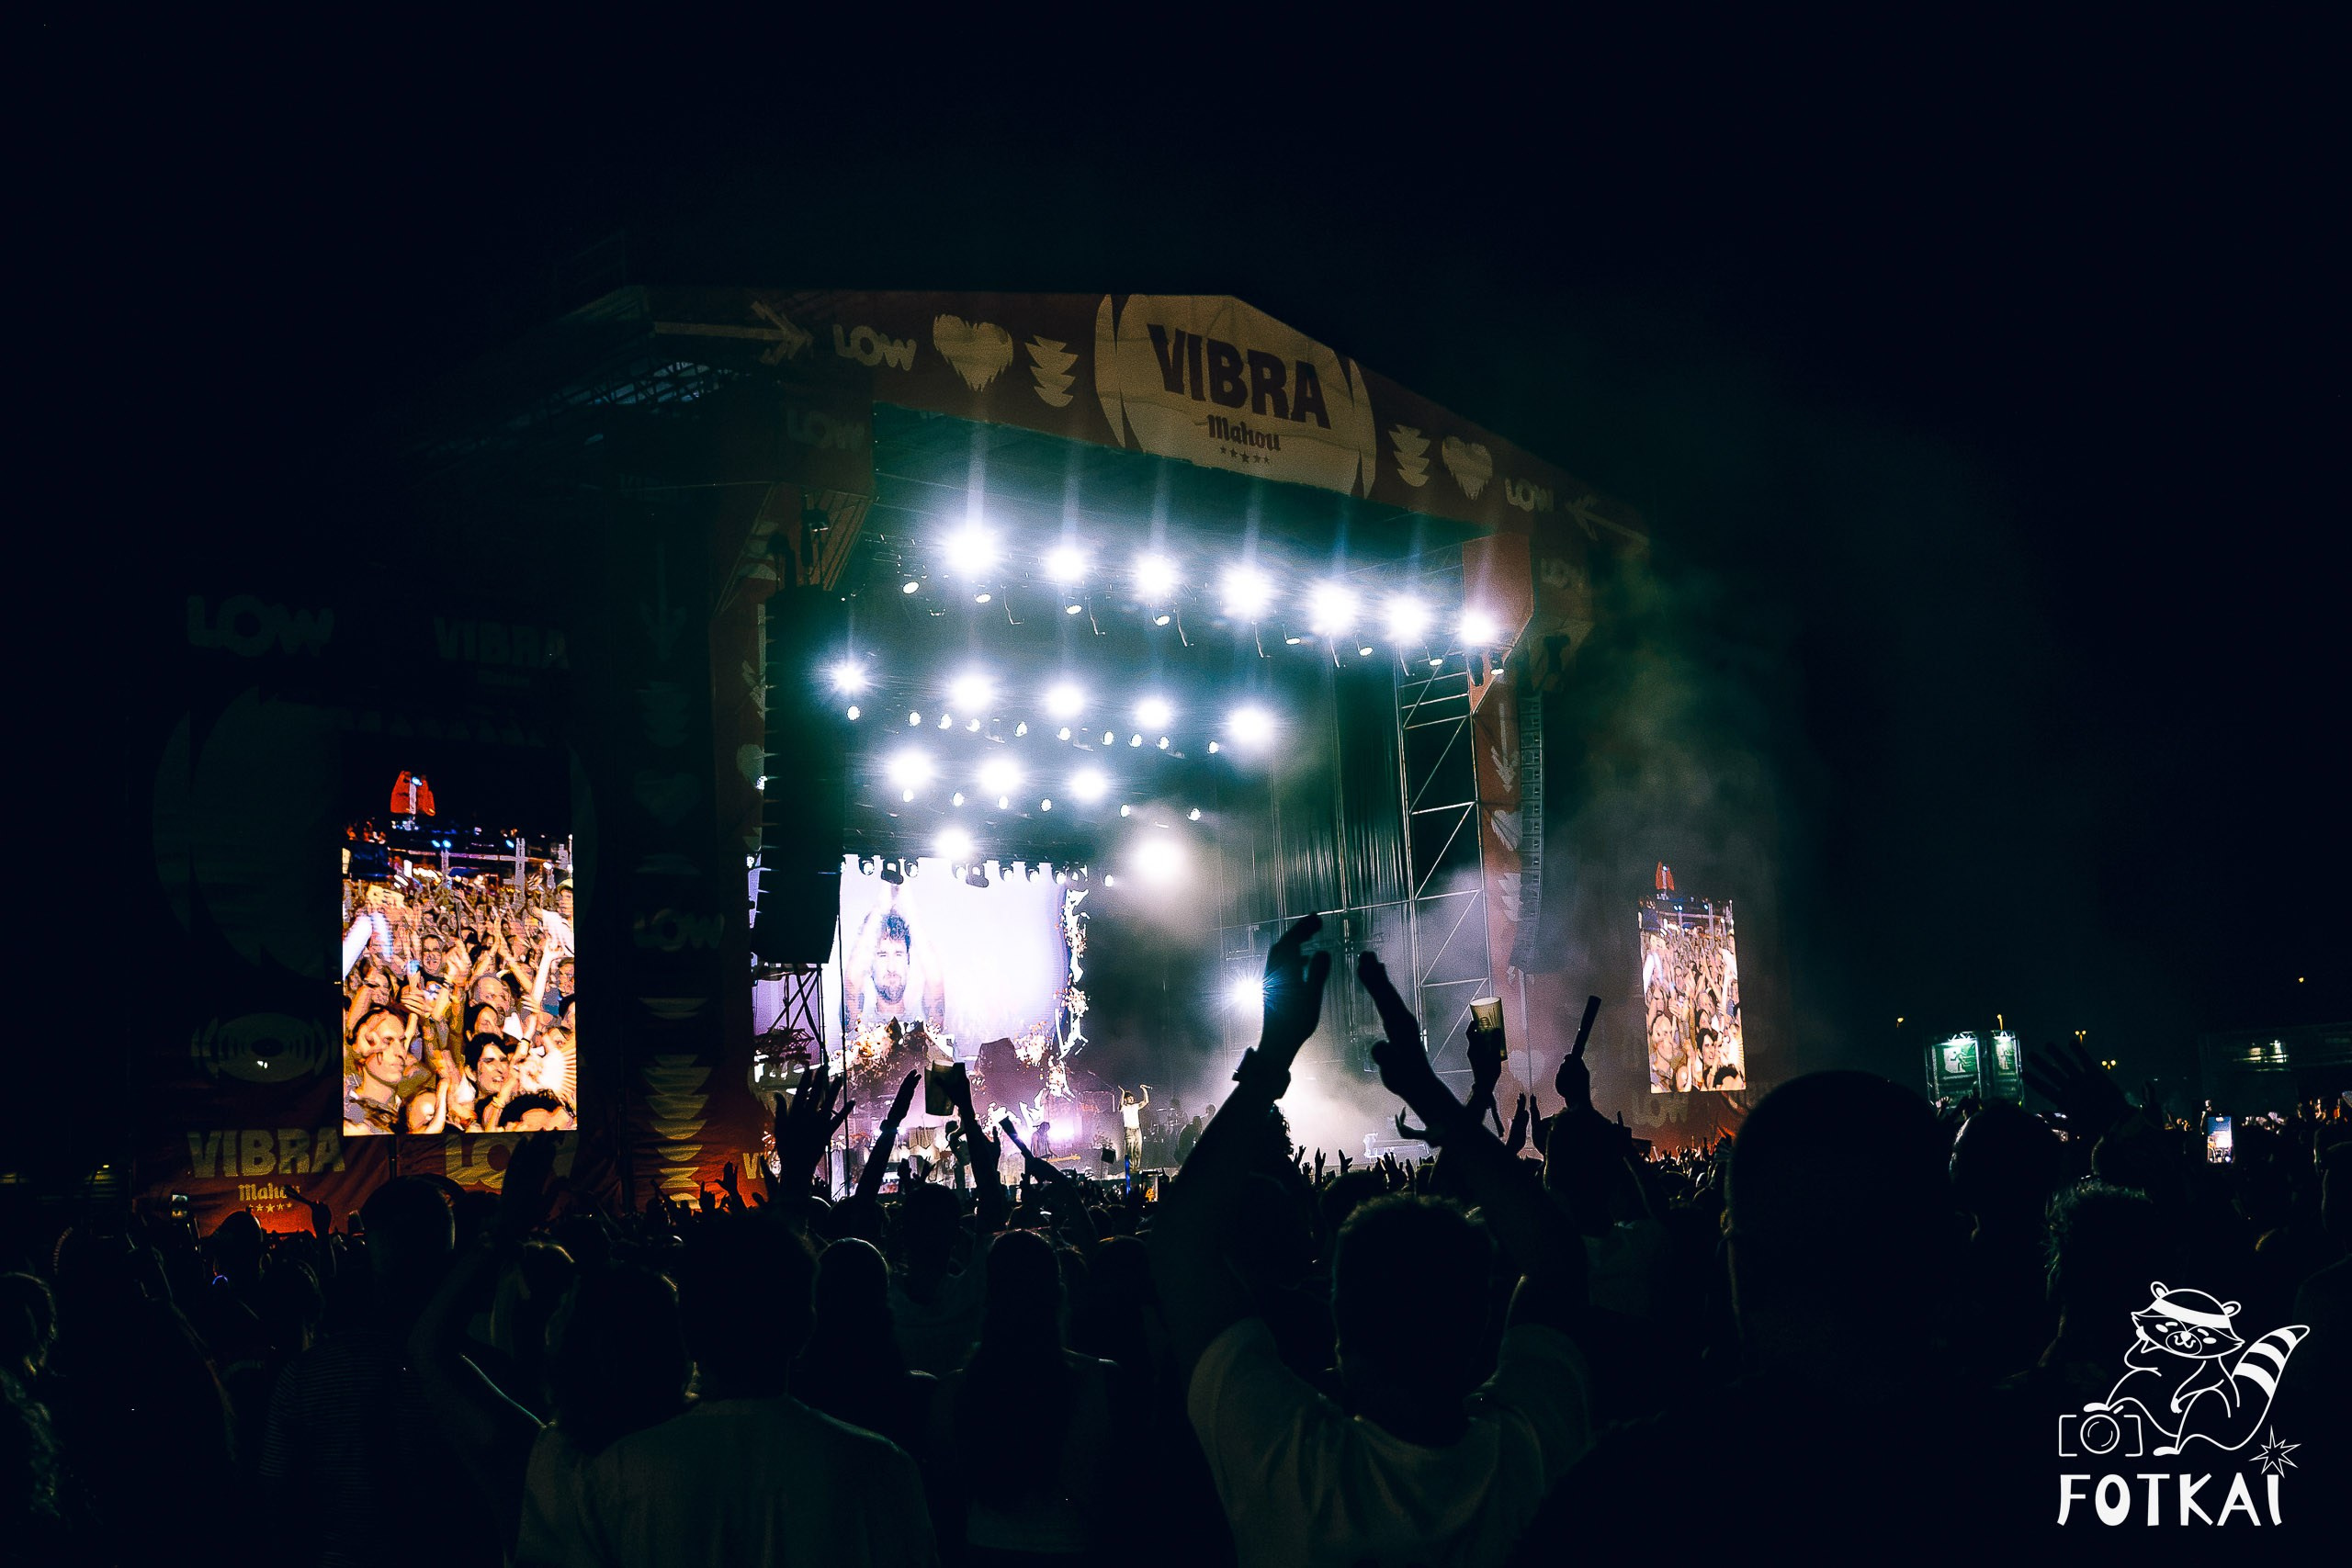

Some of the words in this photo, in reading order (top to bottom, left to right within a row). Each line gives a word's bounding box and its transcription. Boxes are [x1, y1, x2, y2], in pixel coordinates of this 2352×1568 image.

[832, 323, 917, 371] LOW
[1147, 323, 1331, 429] VIBRA
[1207, 414, 1281, 451] Mahou
[187, 594, 335, 658] LOW
[187, 1127, 345, 1179] VIBRA
